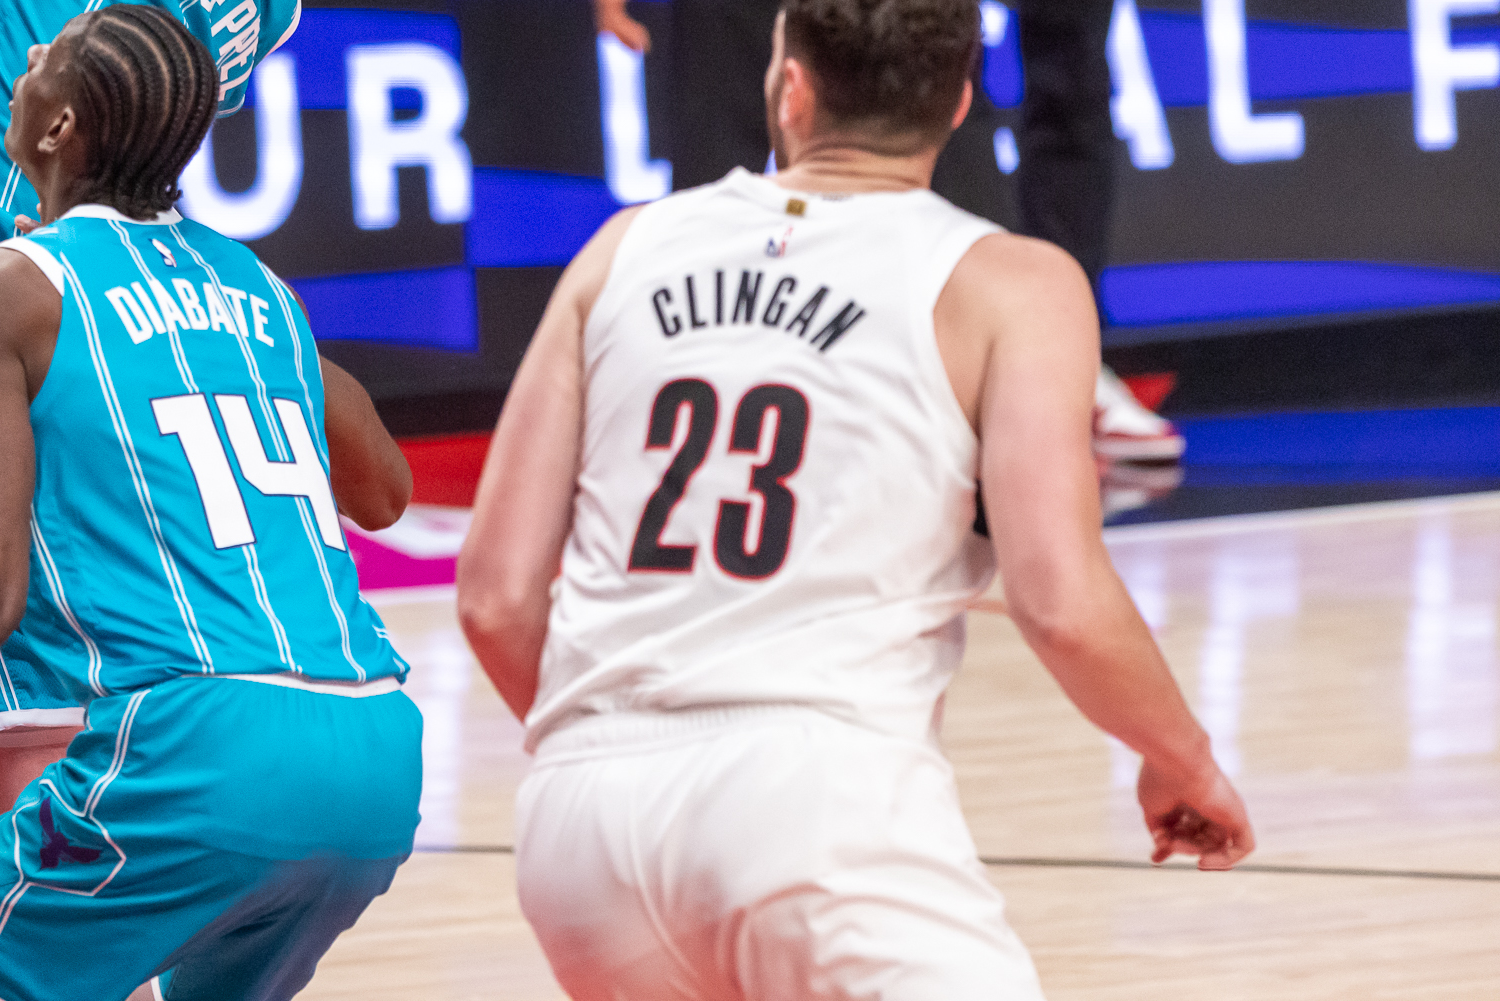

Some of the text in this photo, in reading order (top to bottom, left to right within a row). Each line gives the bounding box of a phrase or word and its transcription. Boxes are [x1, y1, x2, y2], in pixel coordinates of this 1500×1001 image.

[104, 277, 275, 348] DIABATE
[652, 268, 867, 353] CLINGAN
[149, 391, 348, 553] 14
[627, 377, 811, 582] 23
